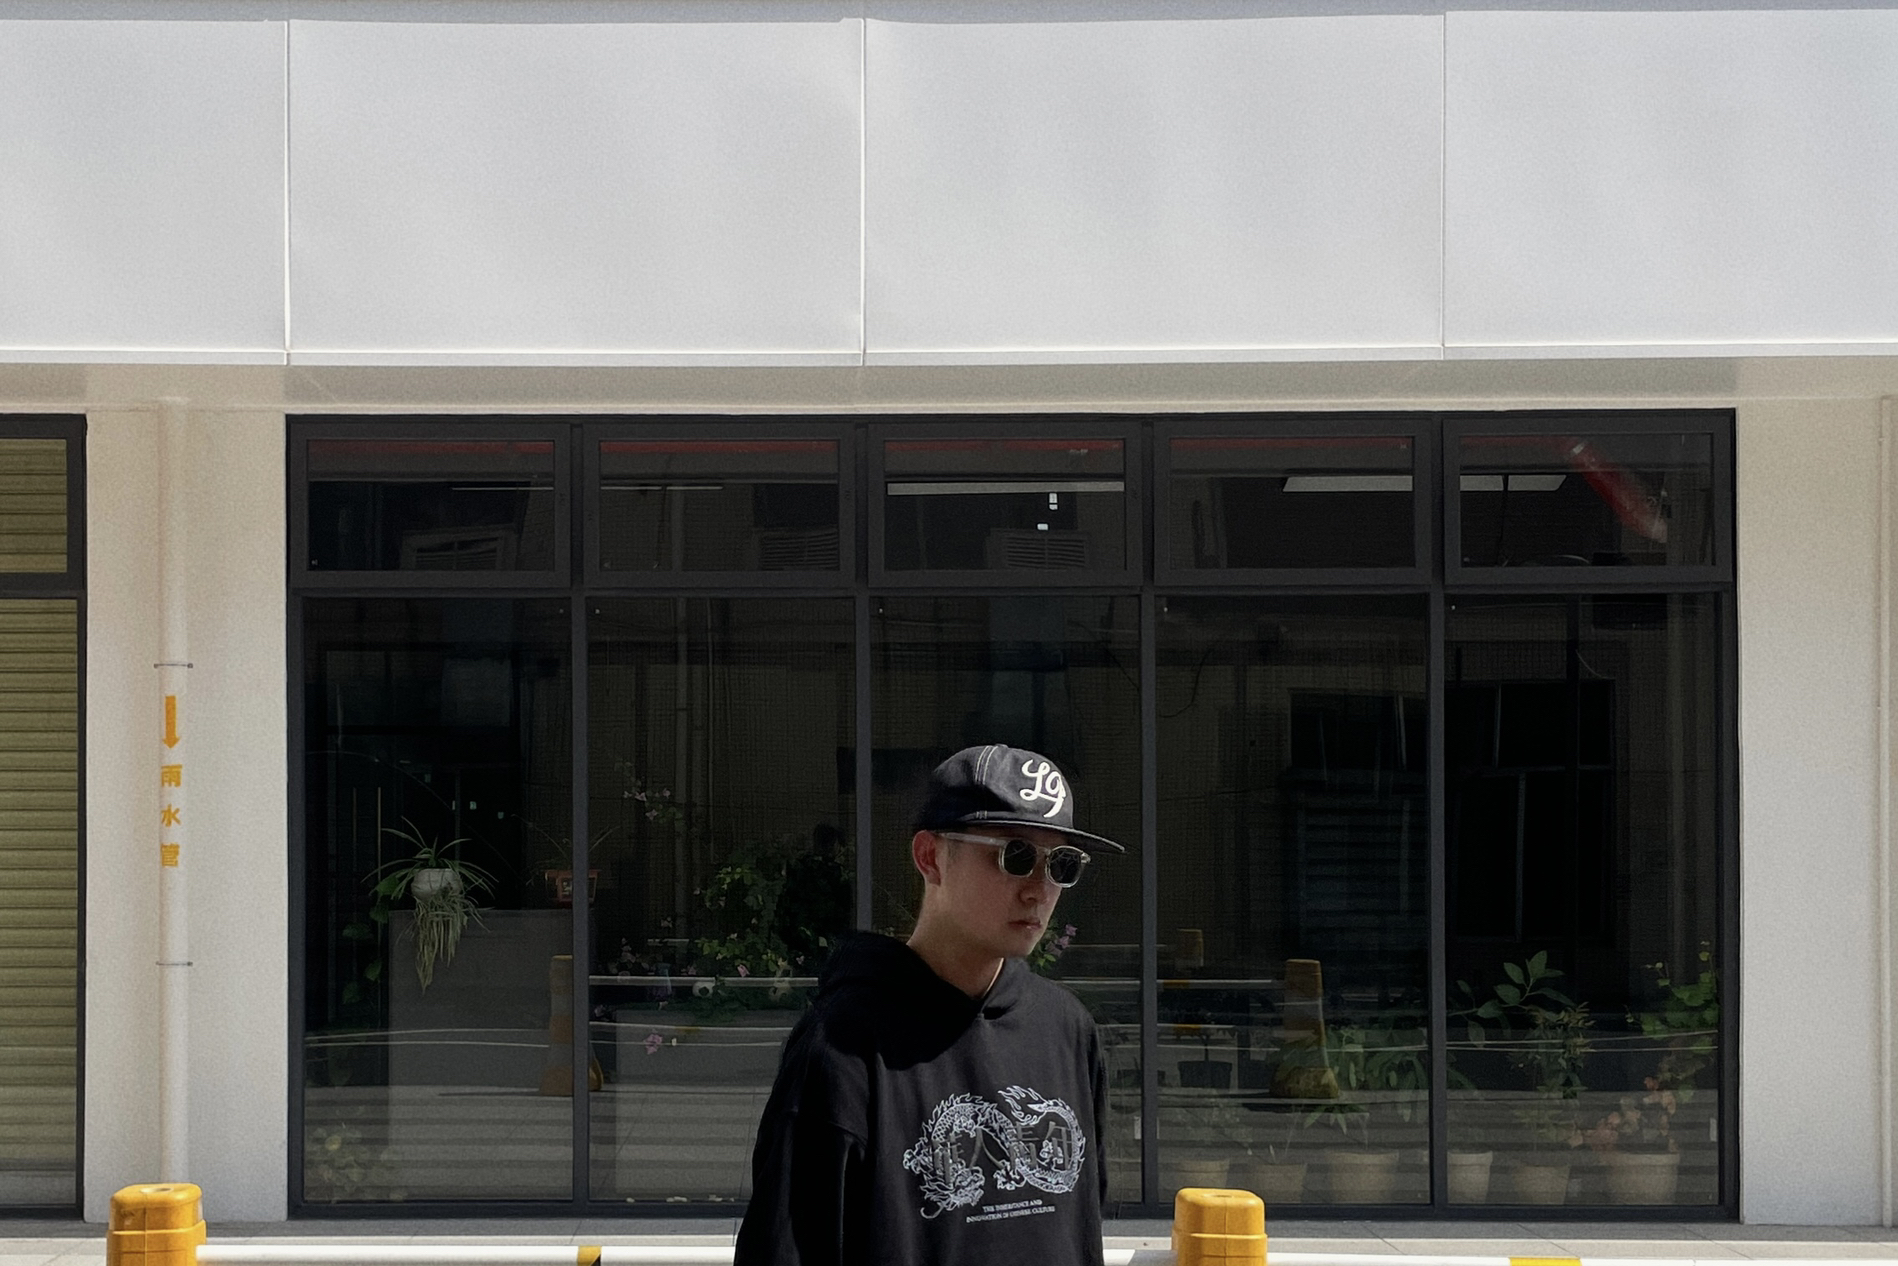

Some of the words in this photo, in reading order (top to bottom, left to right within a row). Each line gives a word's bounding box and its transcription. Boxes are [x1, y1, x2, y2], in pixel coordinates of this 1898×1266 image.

[160, 764, 183, 868] 雨水管
[982, 1205, 995, 1213] THE
